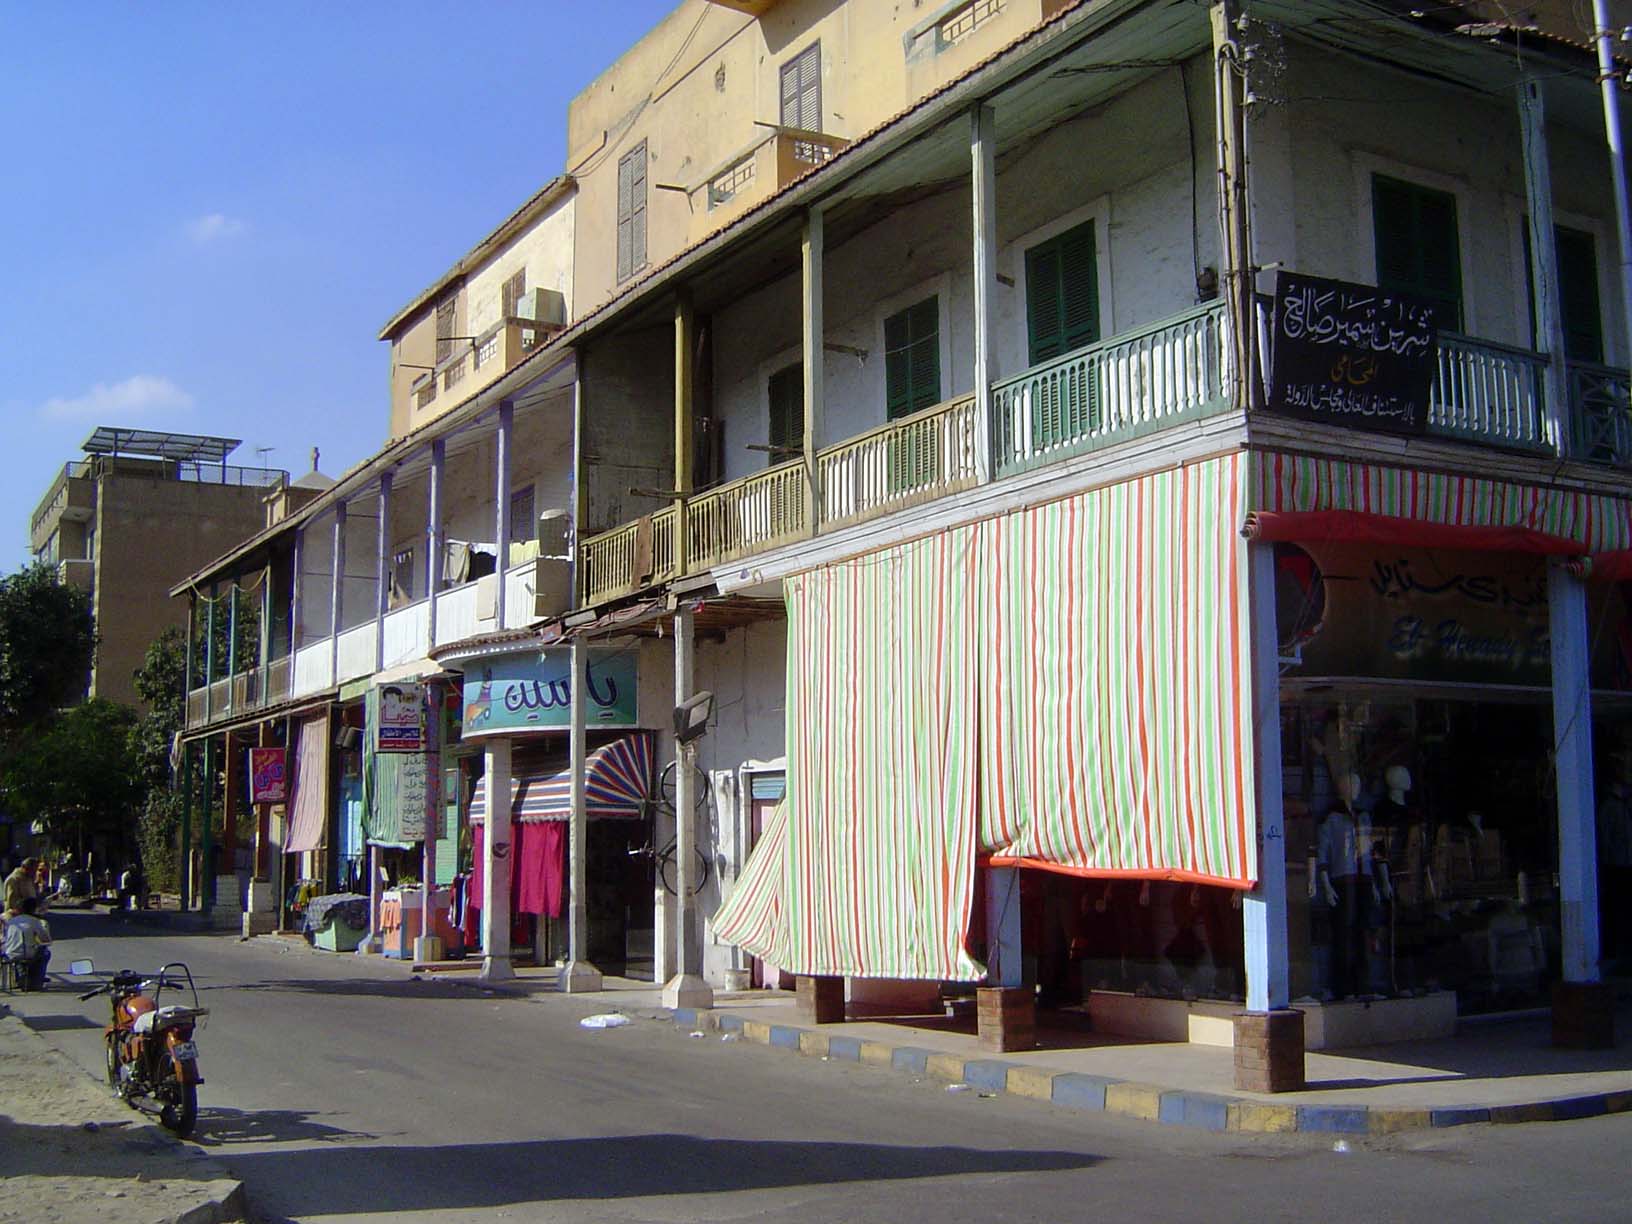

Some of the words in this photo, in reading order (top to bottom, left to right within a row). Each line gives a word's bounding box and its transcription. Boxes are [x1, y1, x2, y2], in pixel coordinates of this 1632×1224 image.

[1284, 285, 1335, 341] صالح
[1316, 303, 1375, 346] سمير
[505, 657, 618, 721] ياسين
